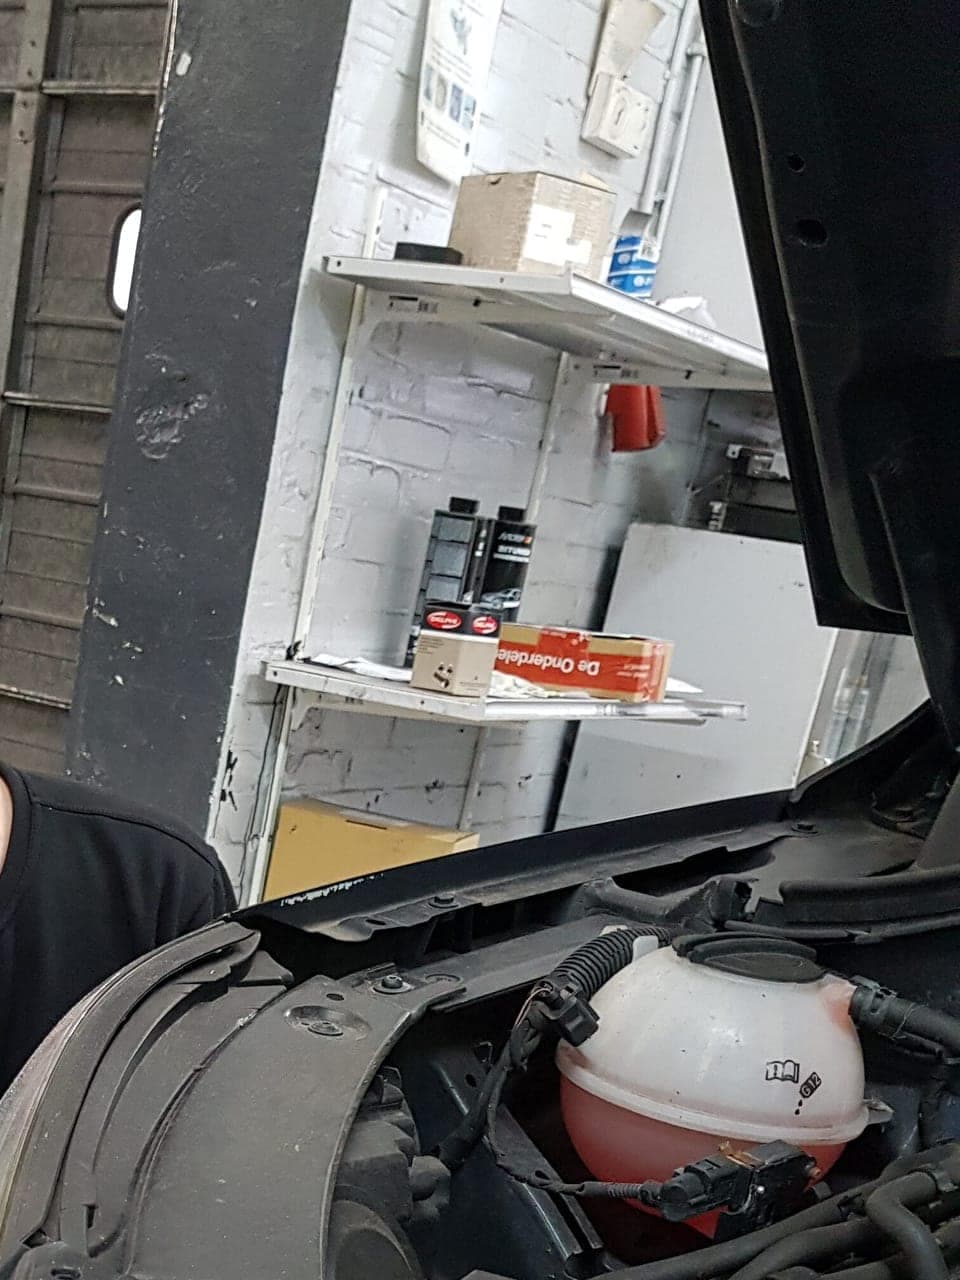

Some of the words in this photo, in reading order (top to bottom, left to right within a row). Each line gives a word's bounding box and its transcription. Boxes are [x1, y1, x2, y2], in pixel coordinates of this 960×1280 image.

[496, 648, 575, 674] Onderdele
[577, 660, 600, 676] De
[801, 1073, 821, 1097] G12
